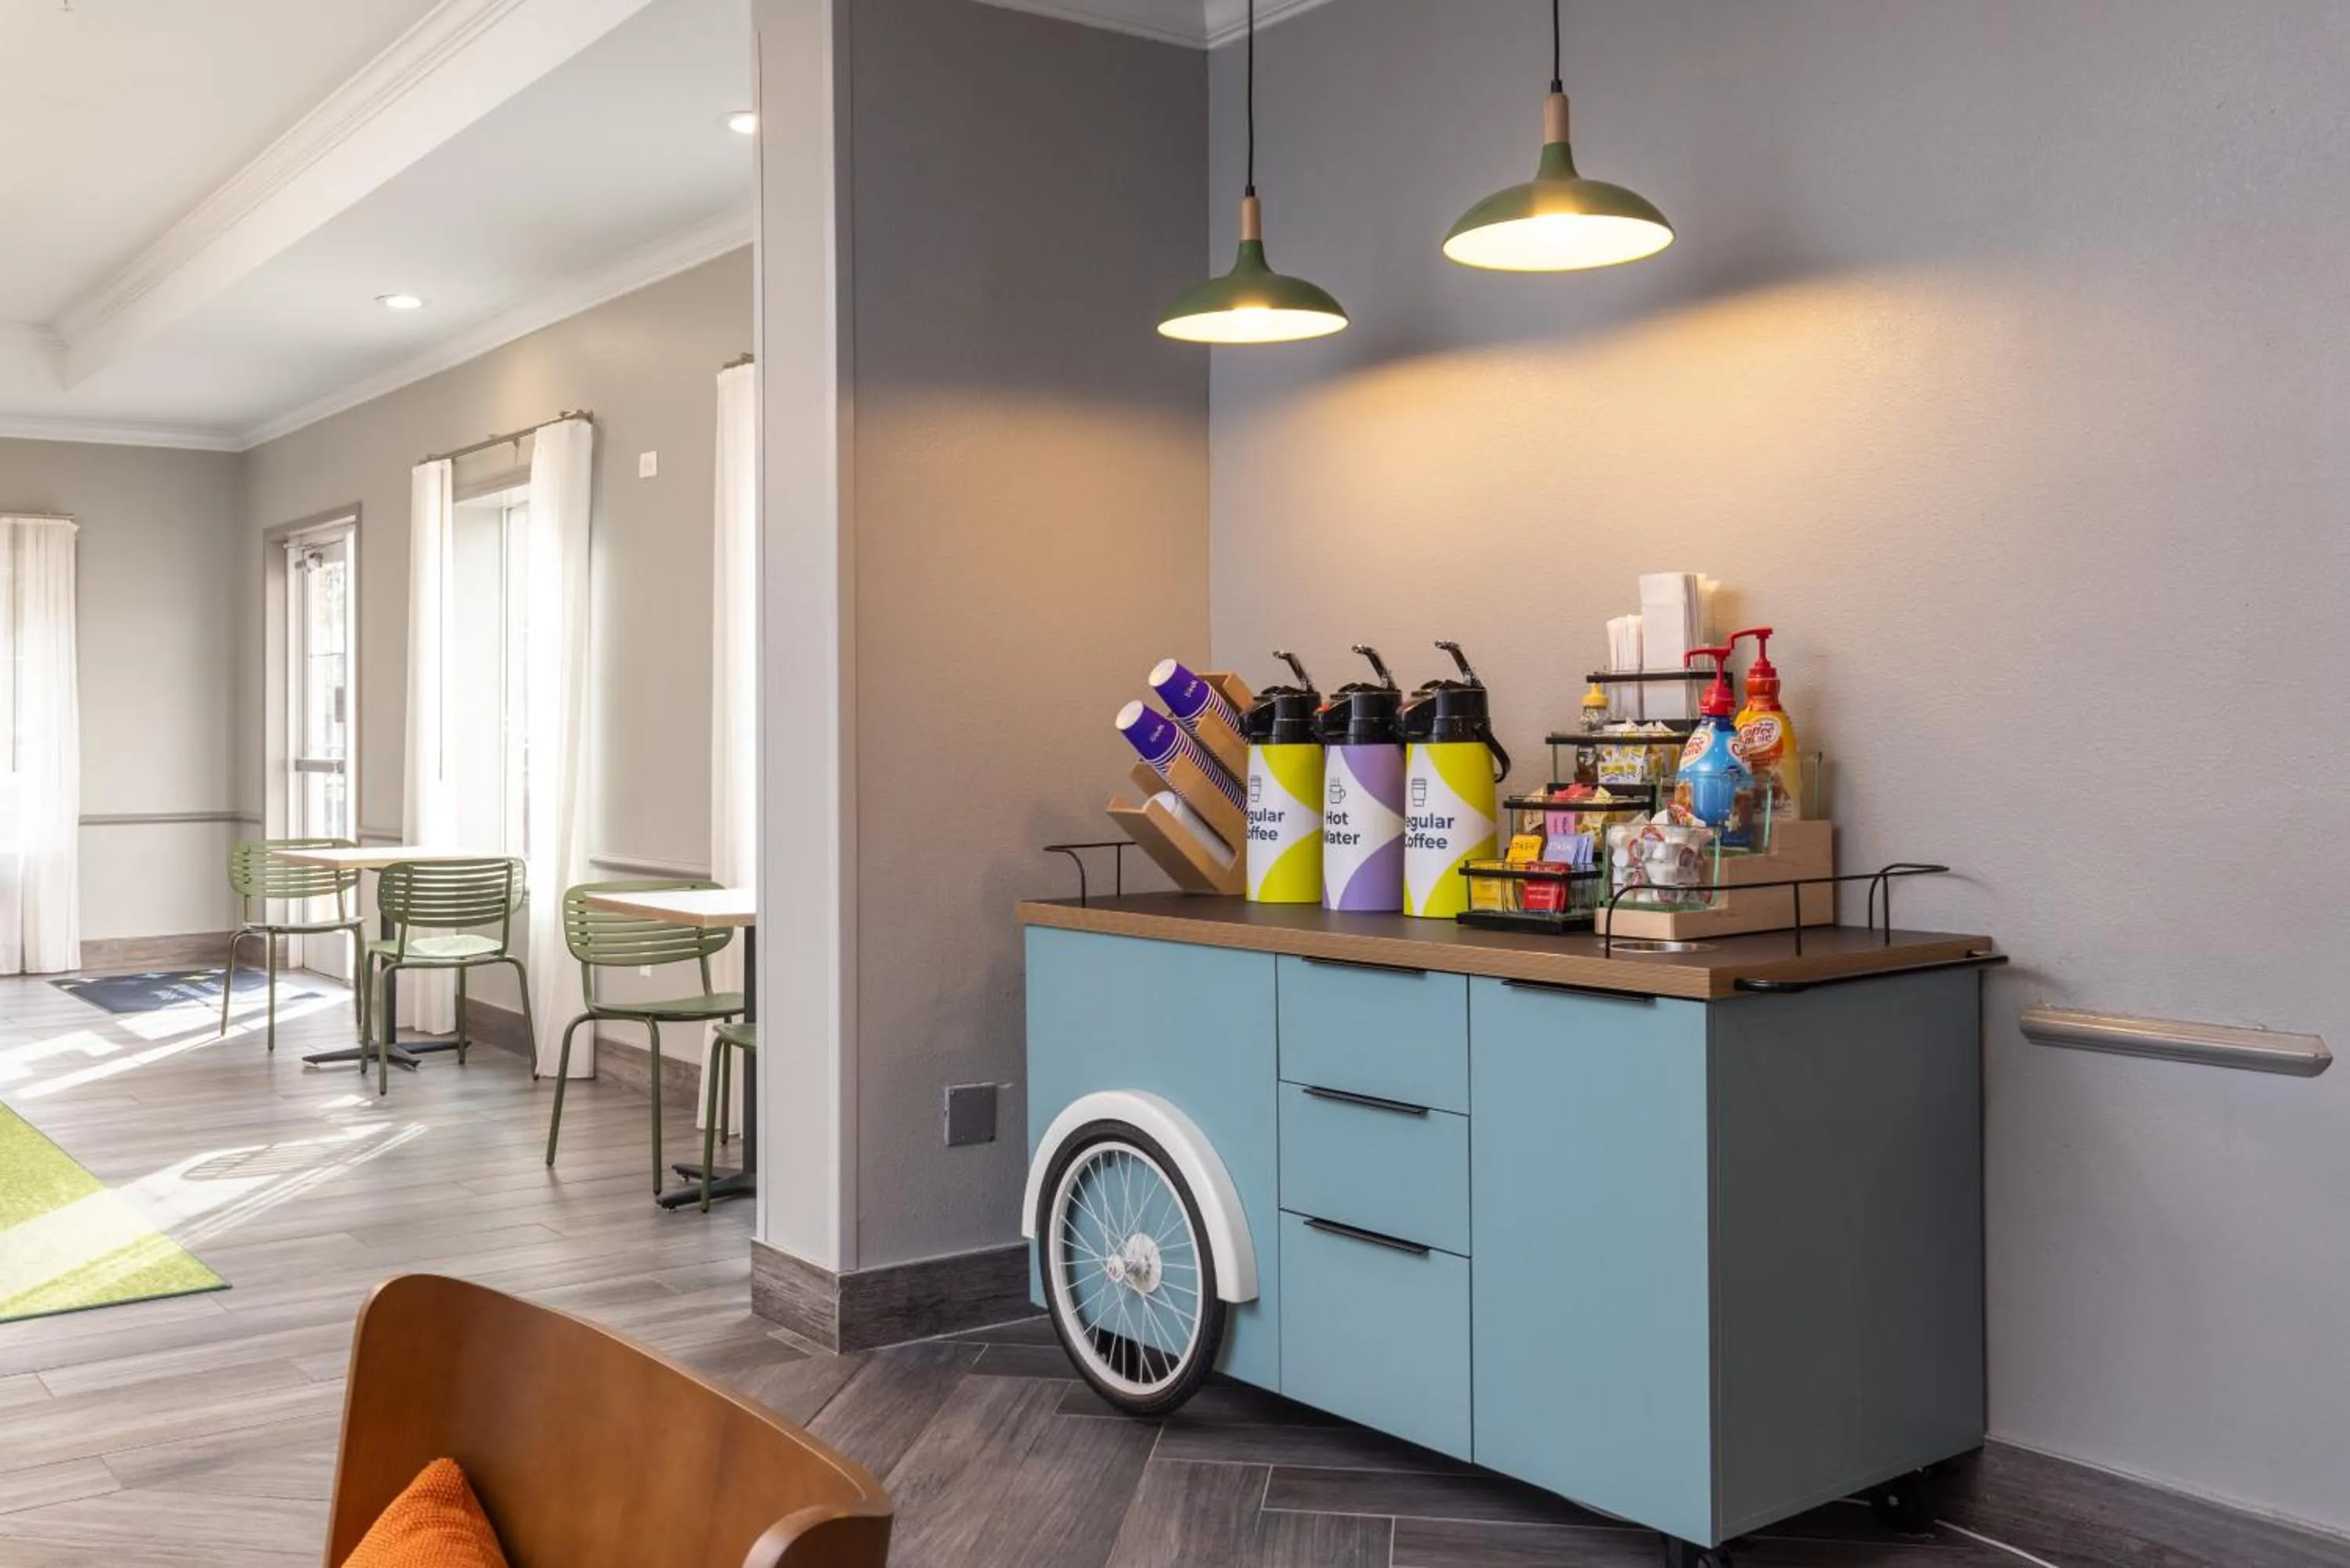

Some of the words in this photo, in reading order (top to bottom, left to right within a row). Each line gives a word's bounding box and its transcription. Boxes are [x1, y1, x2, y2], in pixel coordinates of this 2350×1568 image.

[1247, 807, 1285, 825] gular
[1326, 810, 1349, 825] Hot
[1406, 812, 1455, 832] egular
[1247, 825, 1278, 840] ffee
[1405, 833, 1448, 849] offee
